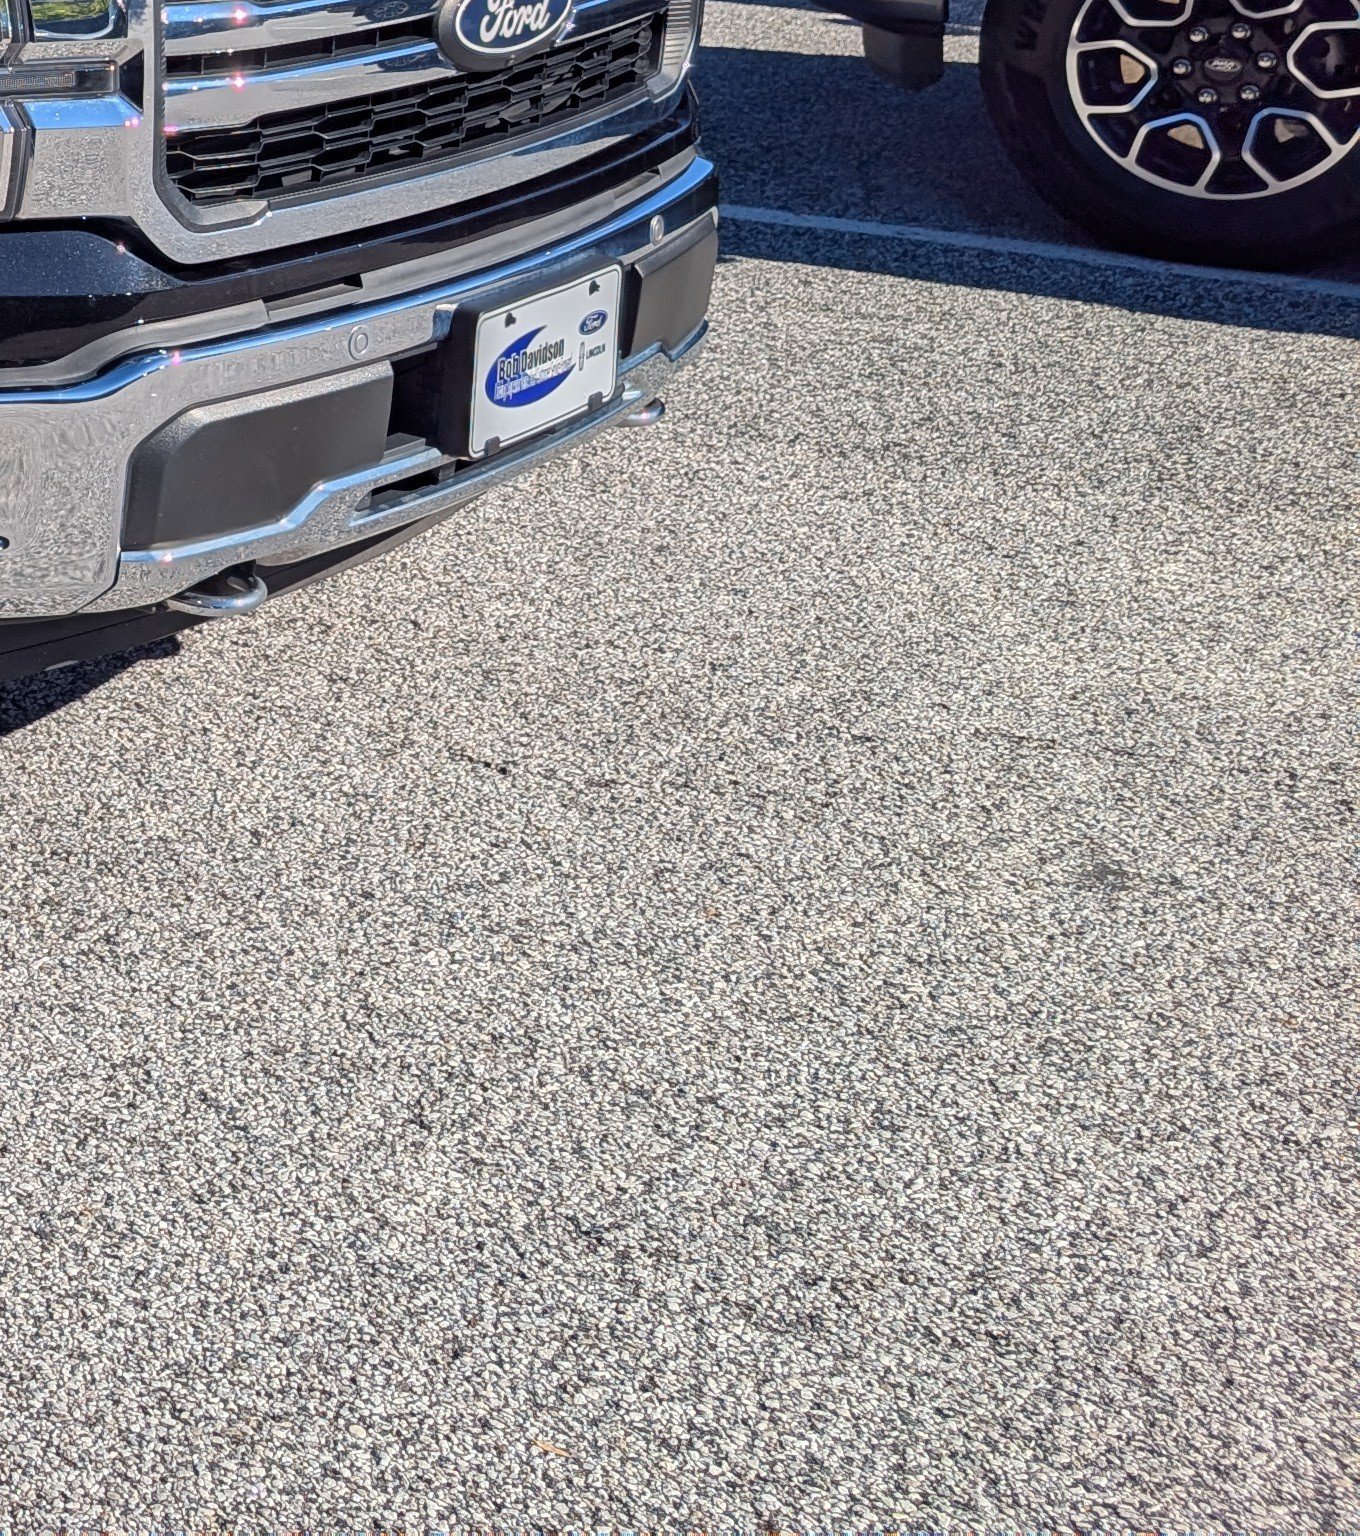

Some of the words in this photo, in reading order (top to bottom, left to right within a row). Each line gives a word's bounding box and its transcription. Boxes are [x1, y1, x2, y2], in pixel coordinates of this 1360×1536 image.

[583, 314, 604, 332] Ford
[498, 357, 520, 383] Bob
[520, 338, 565, 372] Davidson
